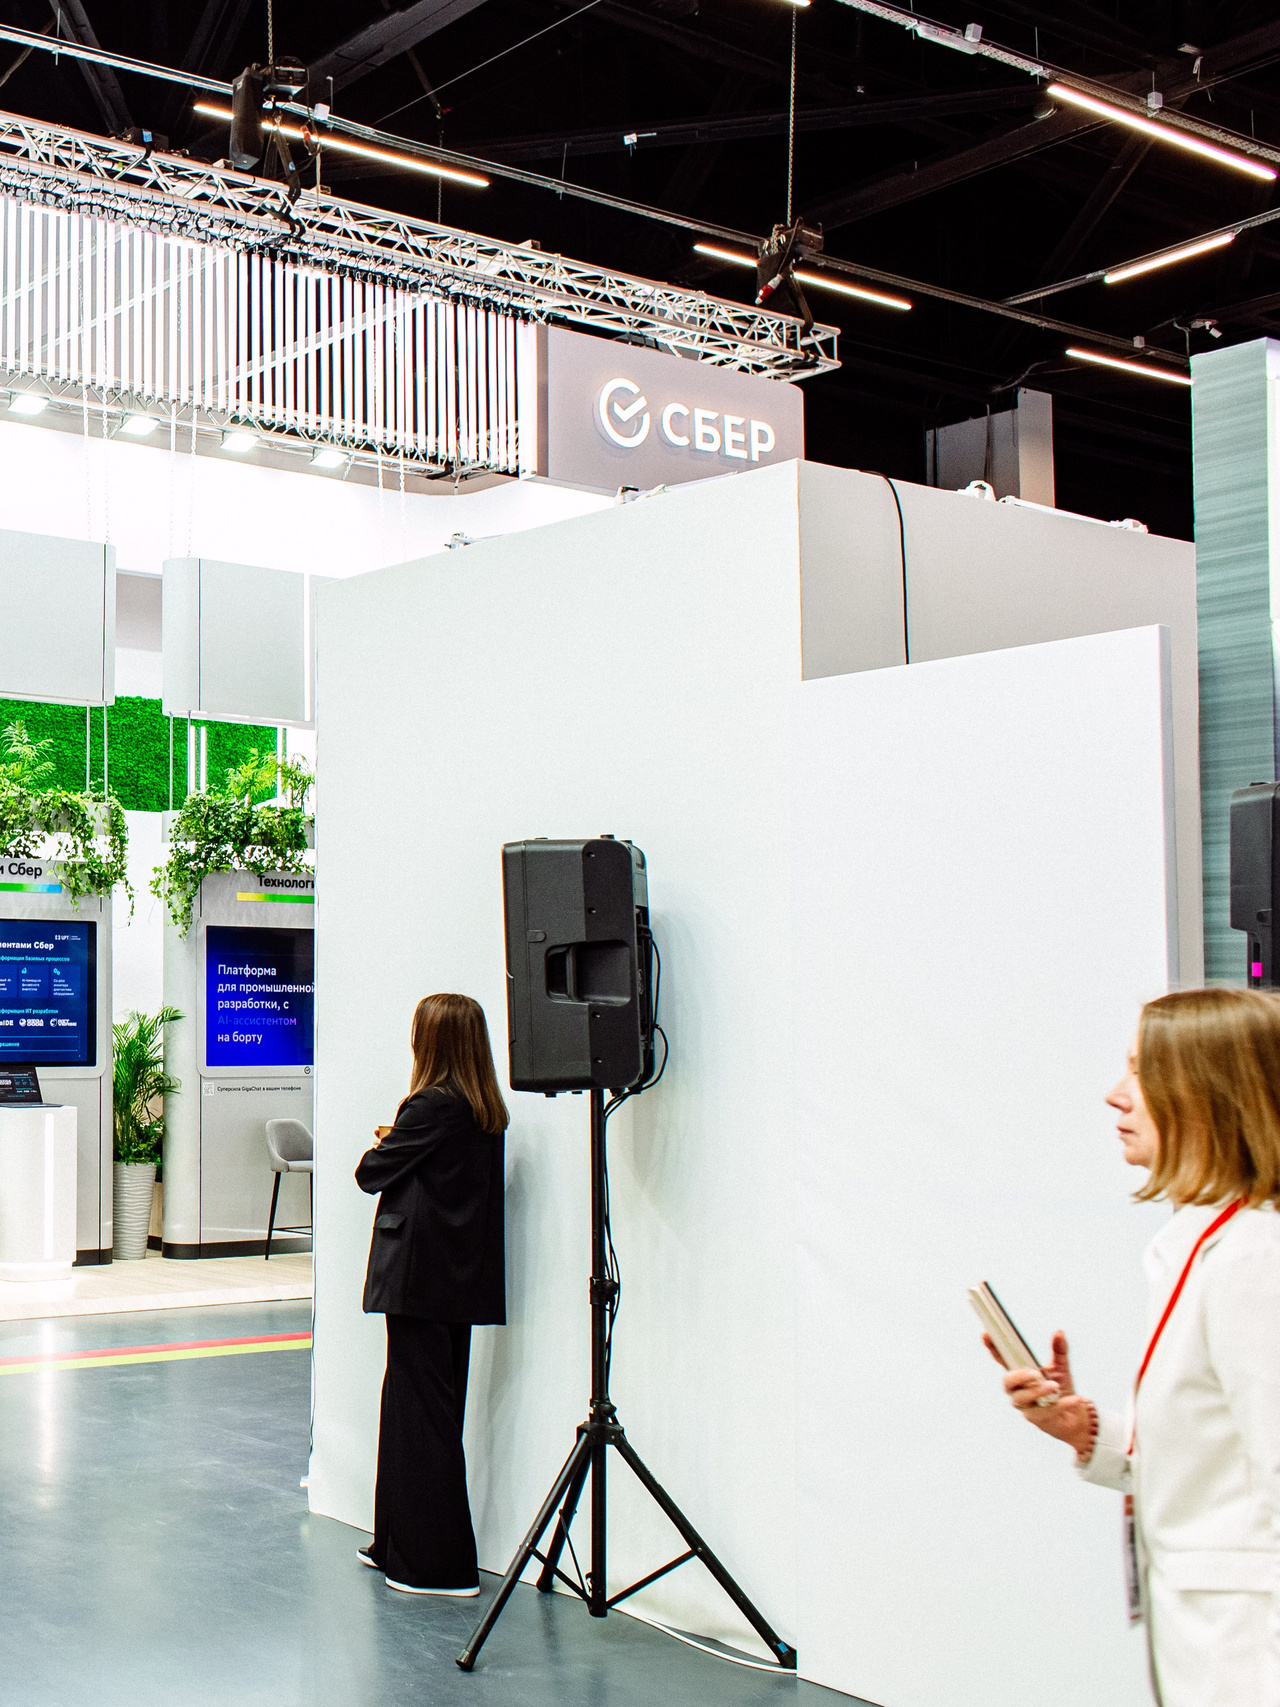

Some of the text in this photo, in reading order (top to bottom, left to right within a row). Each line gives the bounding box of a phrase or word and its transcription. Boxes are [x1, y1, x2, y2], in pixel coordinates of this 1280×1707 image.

[660, 402, 776, 462] СБЕР
[8, 862, 43, 880] Сбер
[33, 941, 54, 951] Сбер
[218, 965, 277, 976] Платформа
[217, 983, 237, 993] для
[218, 999, 281, 1010] разработки,
[218, 1015, 297, 1026] AI-ассистентом
[218, 1031, 263, 1044] на борту
